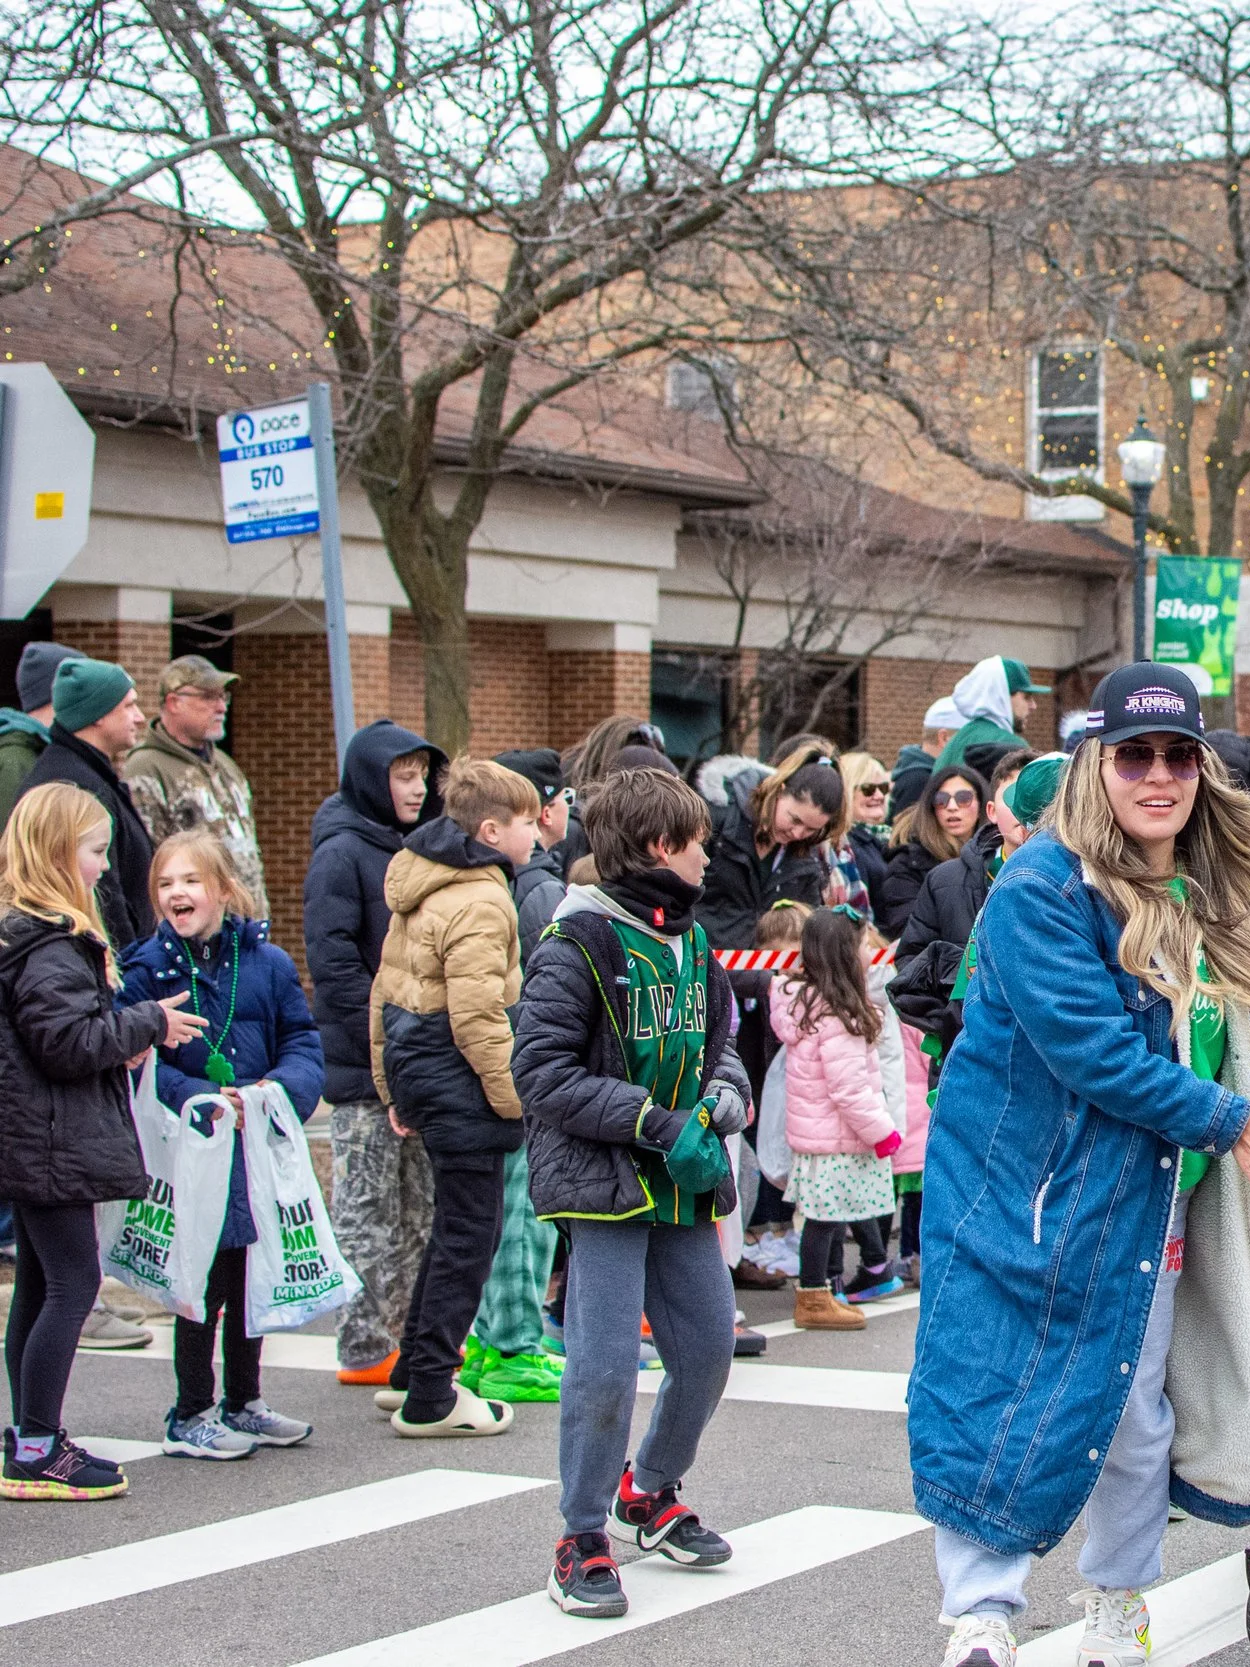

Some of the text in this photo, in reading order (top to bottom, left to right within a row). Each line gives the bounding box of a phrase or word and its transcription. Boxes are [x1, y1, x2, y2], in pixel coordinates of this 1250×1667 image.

[260, 413, 300, 436] pace
[236, 439, 297, 461] BUS STOP
[250, 464, 284, 491] 570
[1156, 598, 1219, 626] Shop
[1125, 696, 1185, 711] JR KNIGHTS
